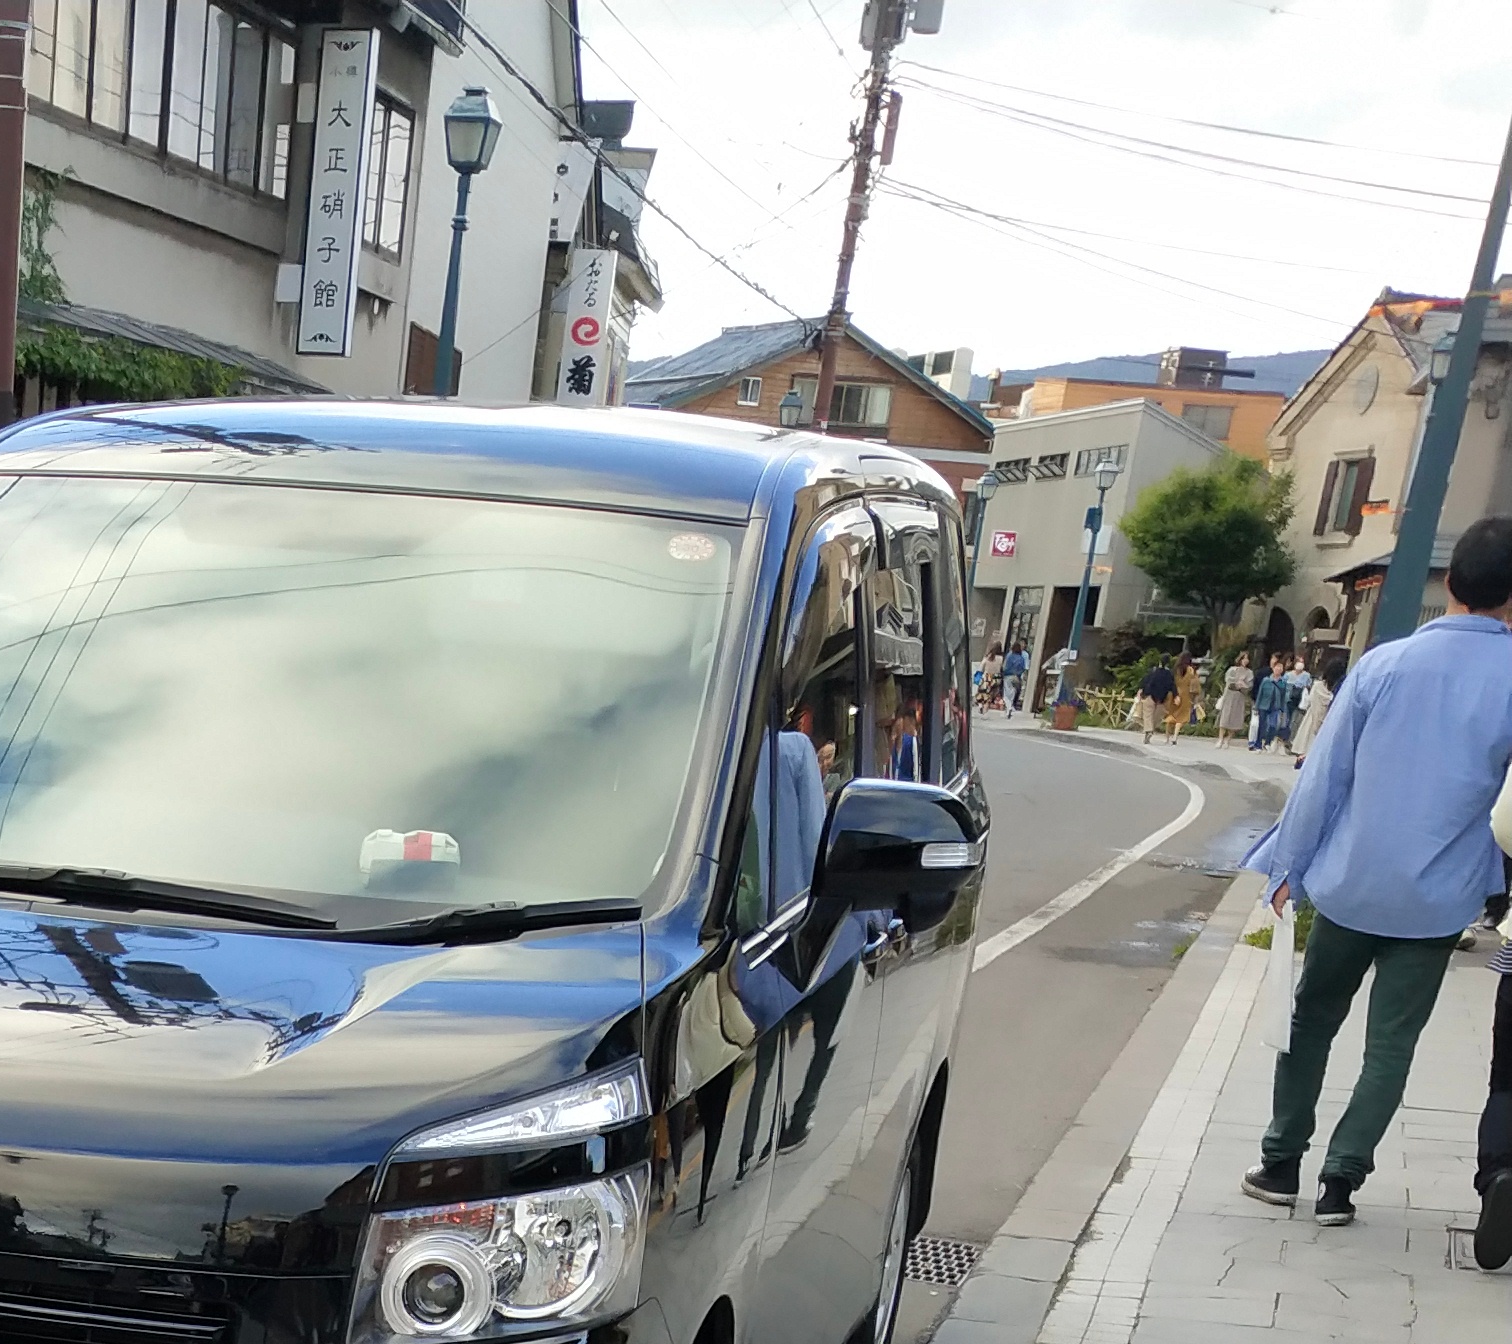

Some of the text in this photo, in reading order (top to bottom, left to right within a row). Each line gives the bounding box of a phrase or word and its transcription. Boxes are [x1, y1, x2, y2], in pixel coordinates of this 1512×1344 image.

[312, 100, 352, 309] 大正硝子館
[565, 354, 597, 396] 菊
